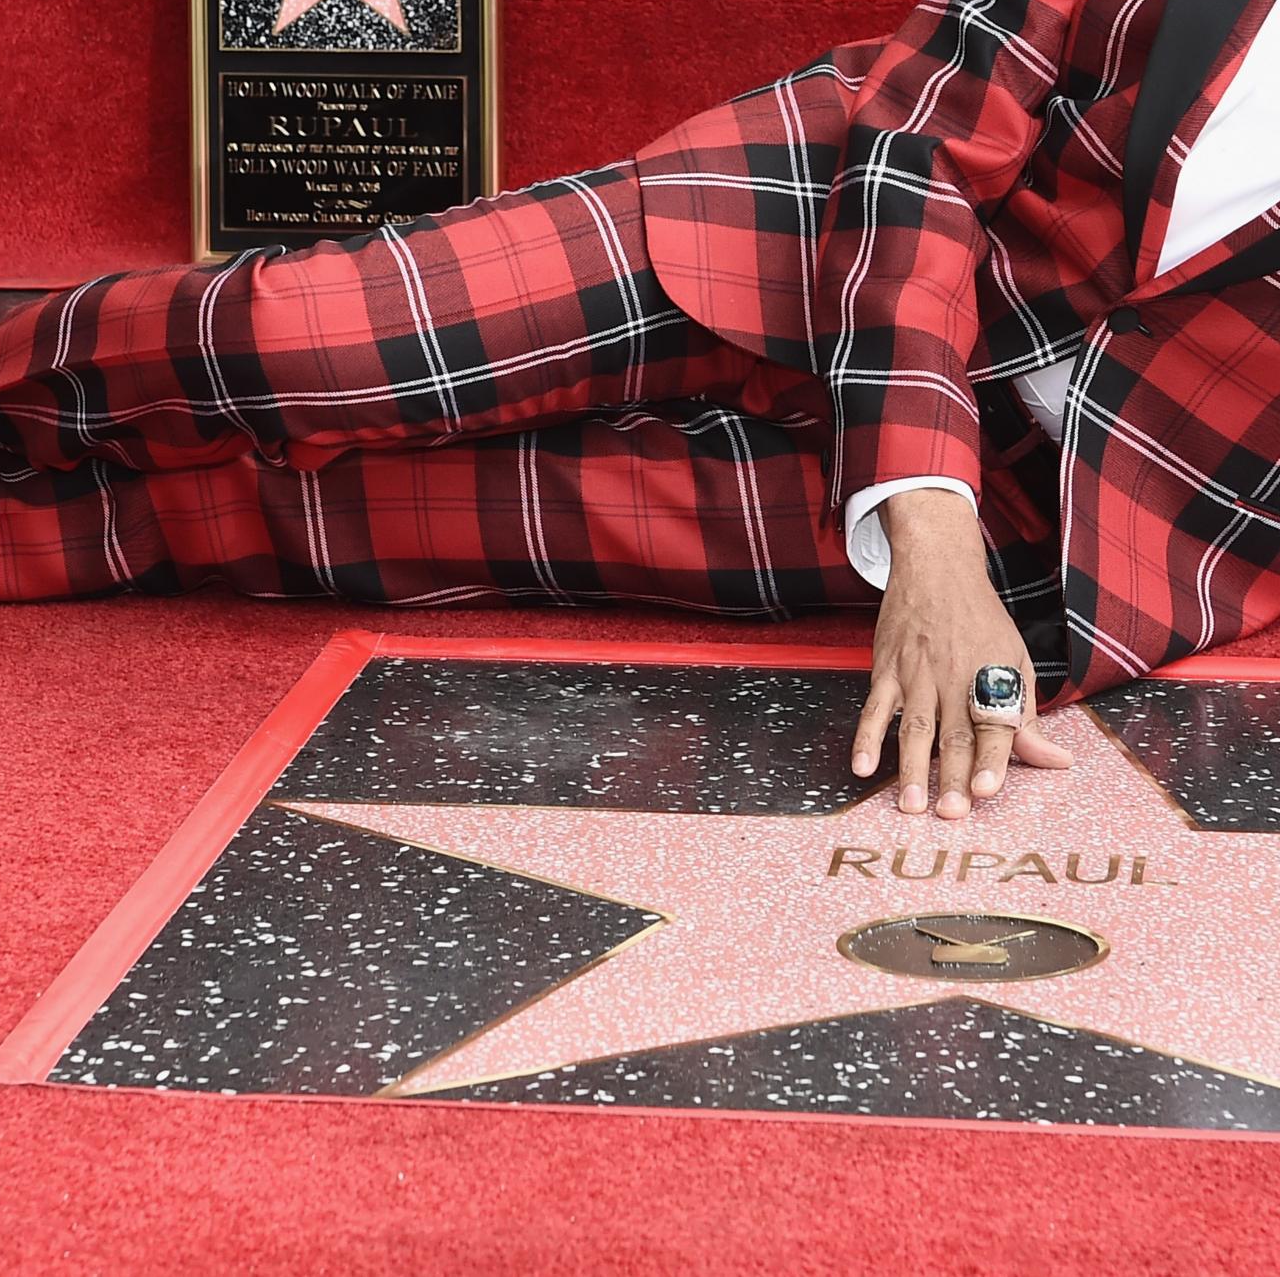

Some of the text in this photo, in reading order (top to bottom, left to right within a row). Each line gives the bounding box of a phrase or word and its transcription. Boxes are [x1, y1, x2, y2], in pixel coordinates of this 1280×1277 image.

[227, 81, 458, 100] HOLLYWOOD WALK OF FAME
[268, 115, 419, 138] RUPAUL
[227, 158, 458, 177] HOLLYWOOD WALK OF FAME
[826, 846, 1179, 887] RUPAUL
